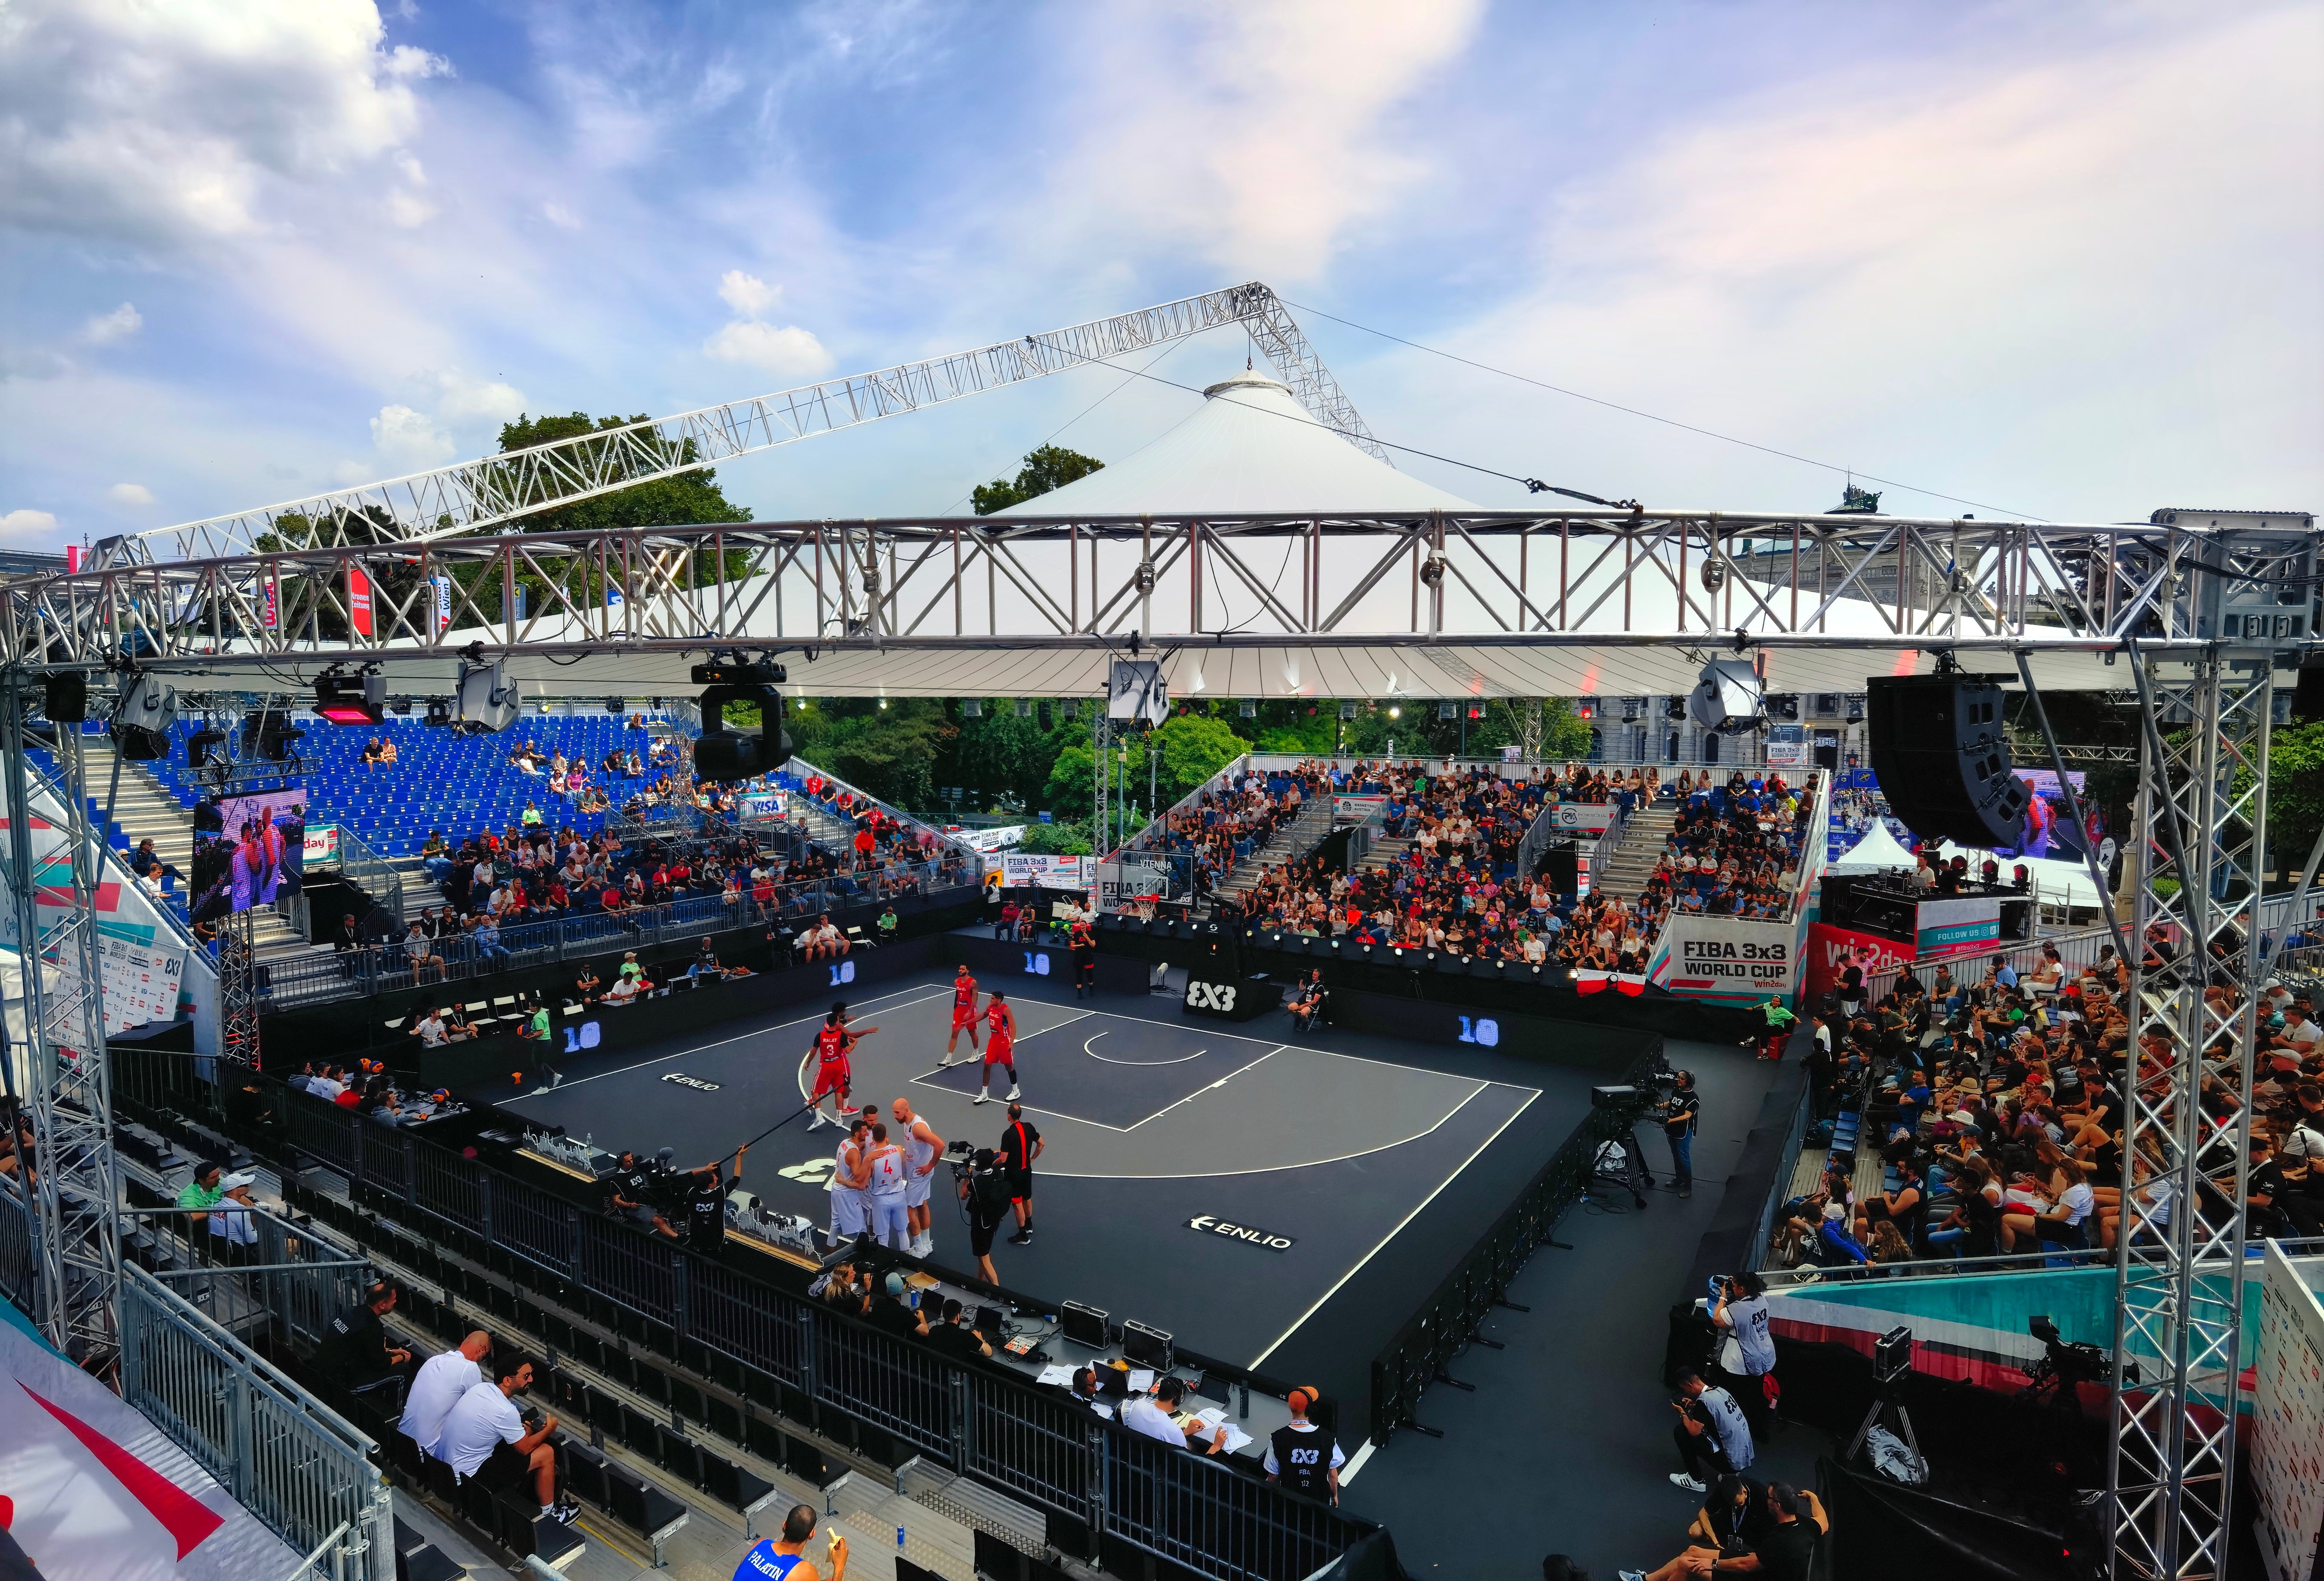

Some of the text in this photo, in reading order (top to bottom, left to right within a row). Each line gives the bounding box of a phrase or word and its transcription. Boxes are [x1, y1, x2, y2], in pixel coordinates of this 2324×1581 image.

[1140, 860, 1172, 870] VIENNA
[1938, 931, 1967, 940] FOLLOW
[1684, 941, 1786, 959] FIBA 3x3
[1685, 962, 1787, 978] WORLD CUP
[1754, 980, 1786, 988] win2day
[827, 1044, 834, 1055] 3
[675, 1077, 719, 1090] ENLIO
[884, 1159, 893, 1175] 4
[1214, 1223, 1291, 1248] ENLIO
[333, 1318, 349, 1334] POLIZEI
[748, 1551, 784, 1581] PALATIN
